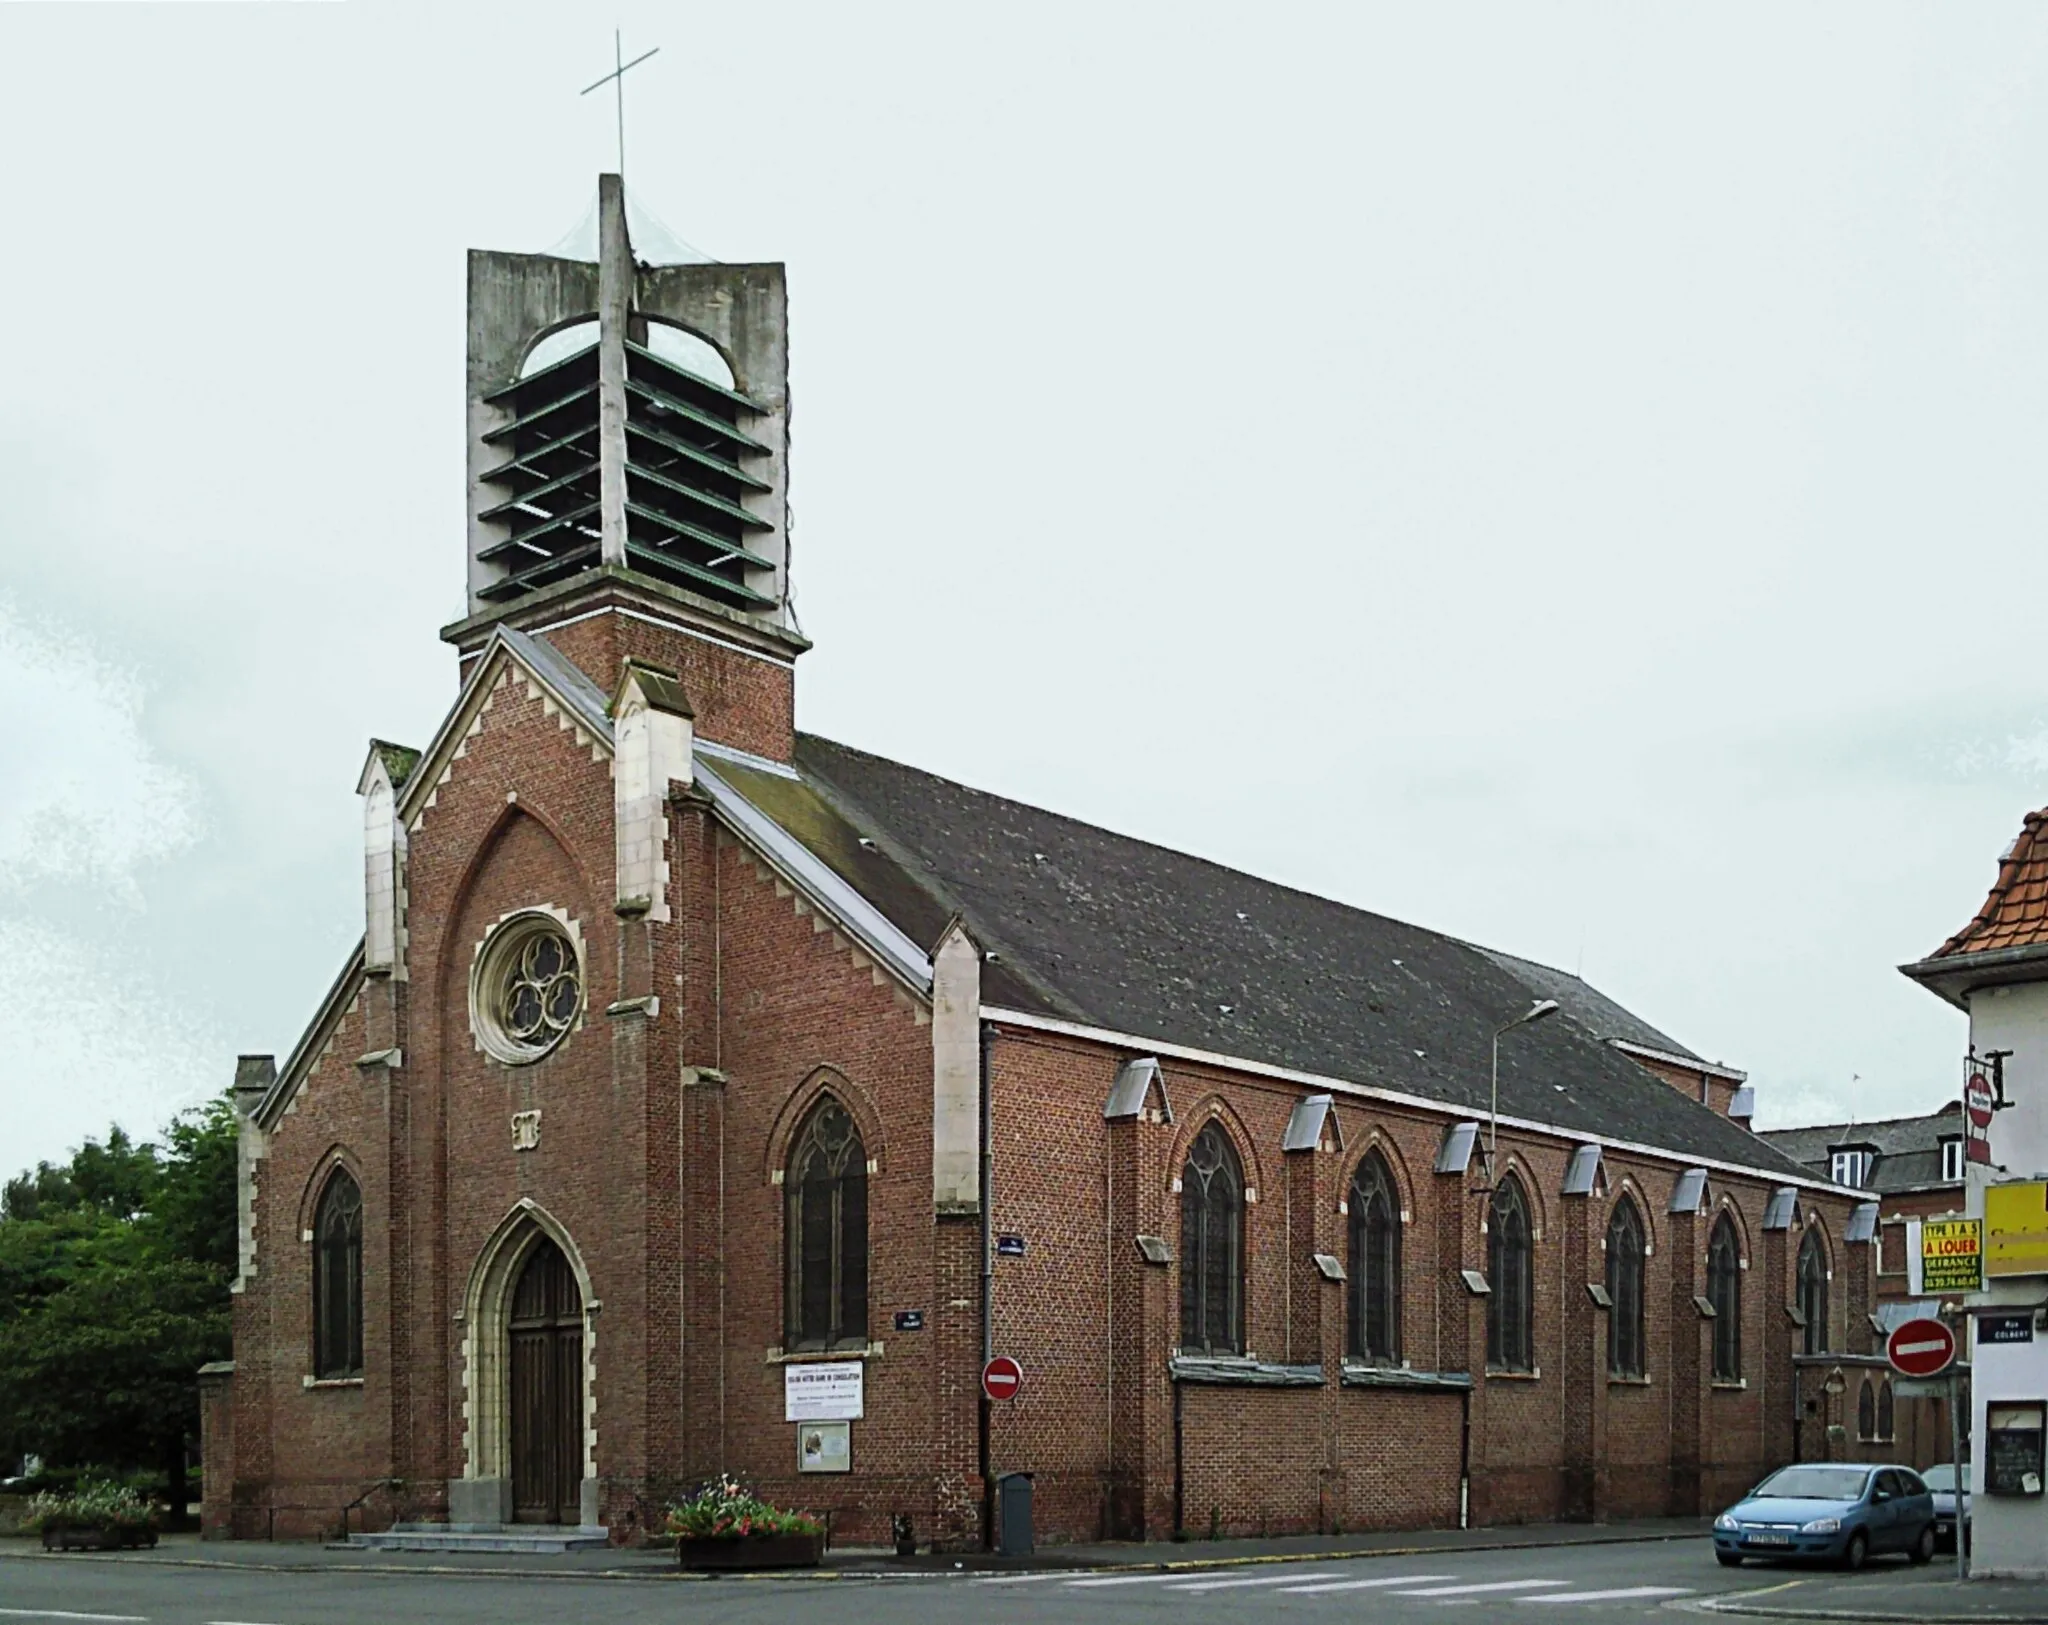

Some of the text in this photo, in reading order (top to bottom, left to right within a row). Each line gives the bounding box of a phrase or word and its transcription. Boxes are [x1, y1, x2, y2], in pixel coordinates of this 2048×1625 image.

[1925, 1222, 1977, 1236] TYPE 1 A 5
[1926, 1239, 1976, 1255] A LOUER
[2005, 1320, 2019, 1328] Rue
[1994, 1330, 2029, 1339] COLBERT
